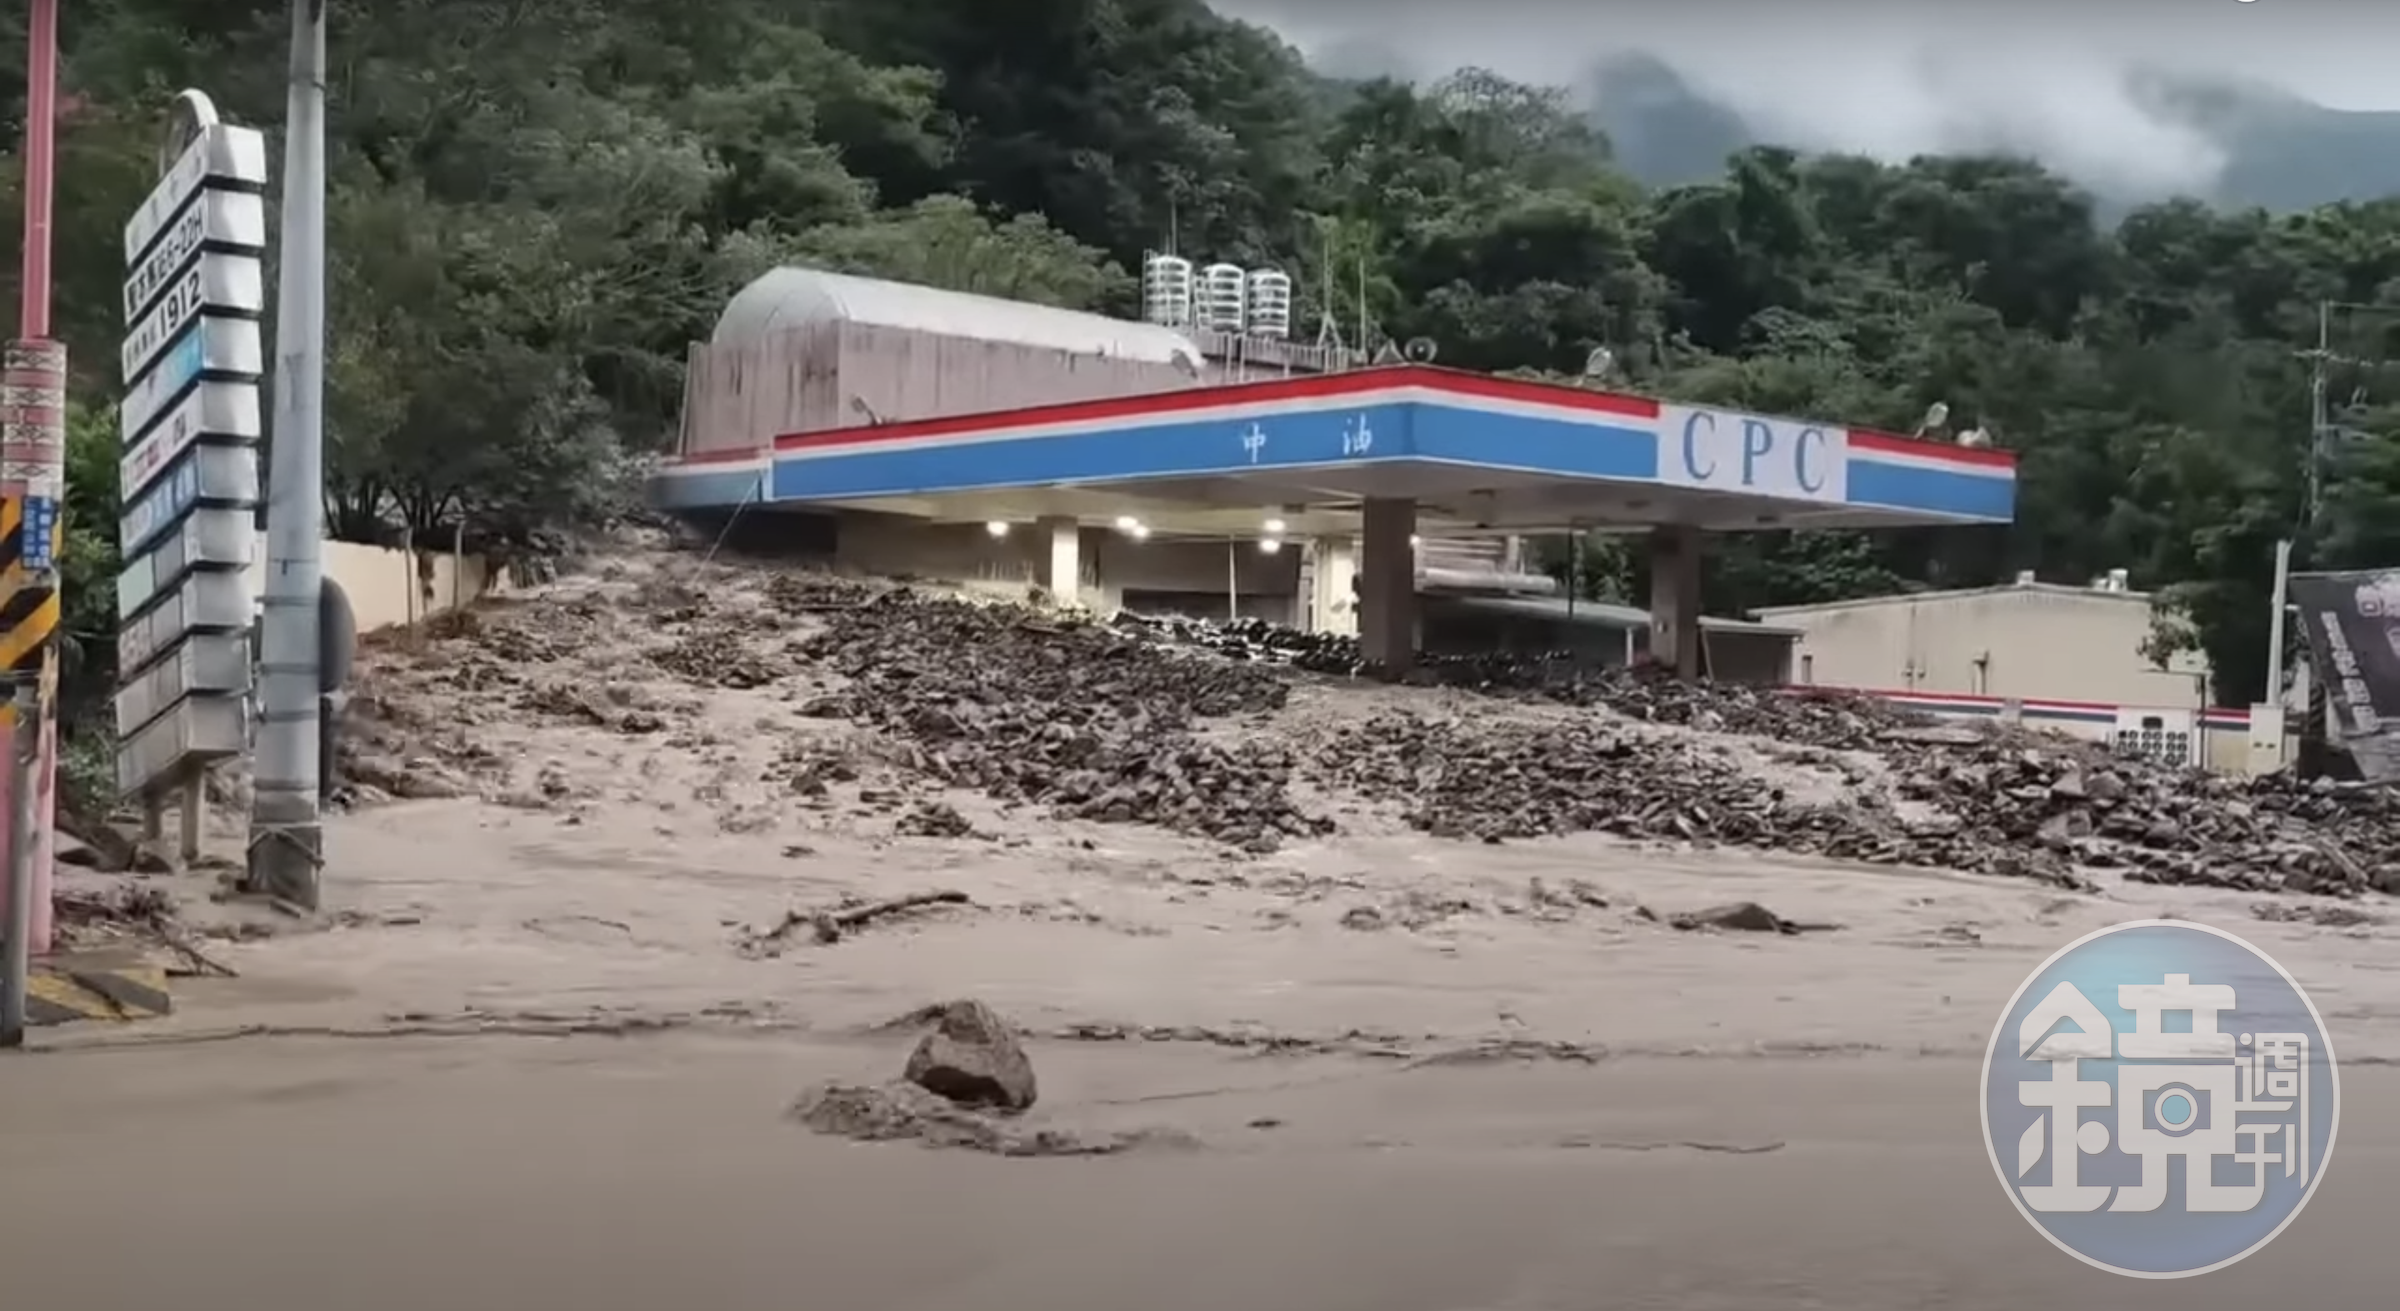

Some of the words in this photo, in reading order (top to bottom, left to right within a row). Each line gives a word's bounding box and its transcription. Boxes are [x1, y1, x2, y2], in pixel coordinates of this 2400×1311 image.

[160, 270, 201, 337] 1912
[1243, 412, 1373, 465] 中油
[1683, 411, 1825, 493] CPC
